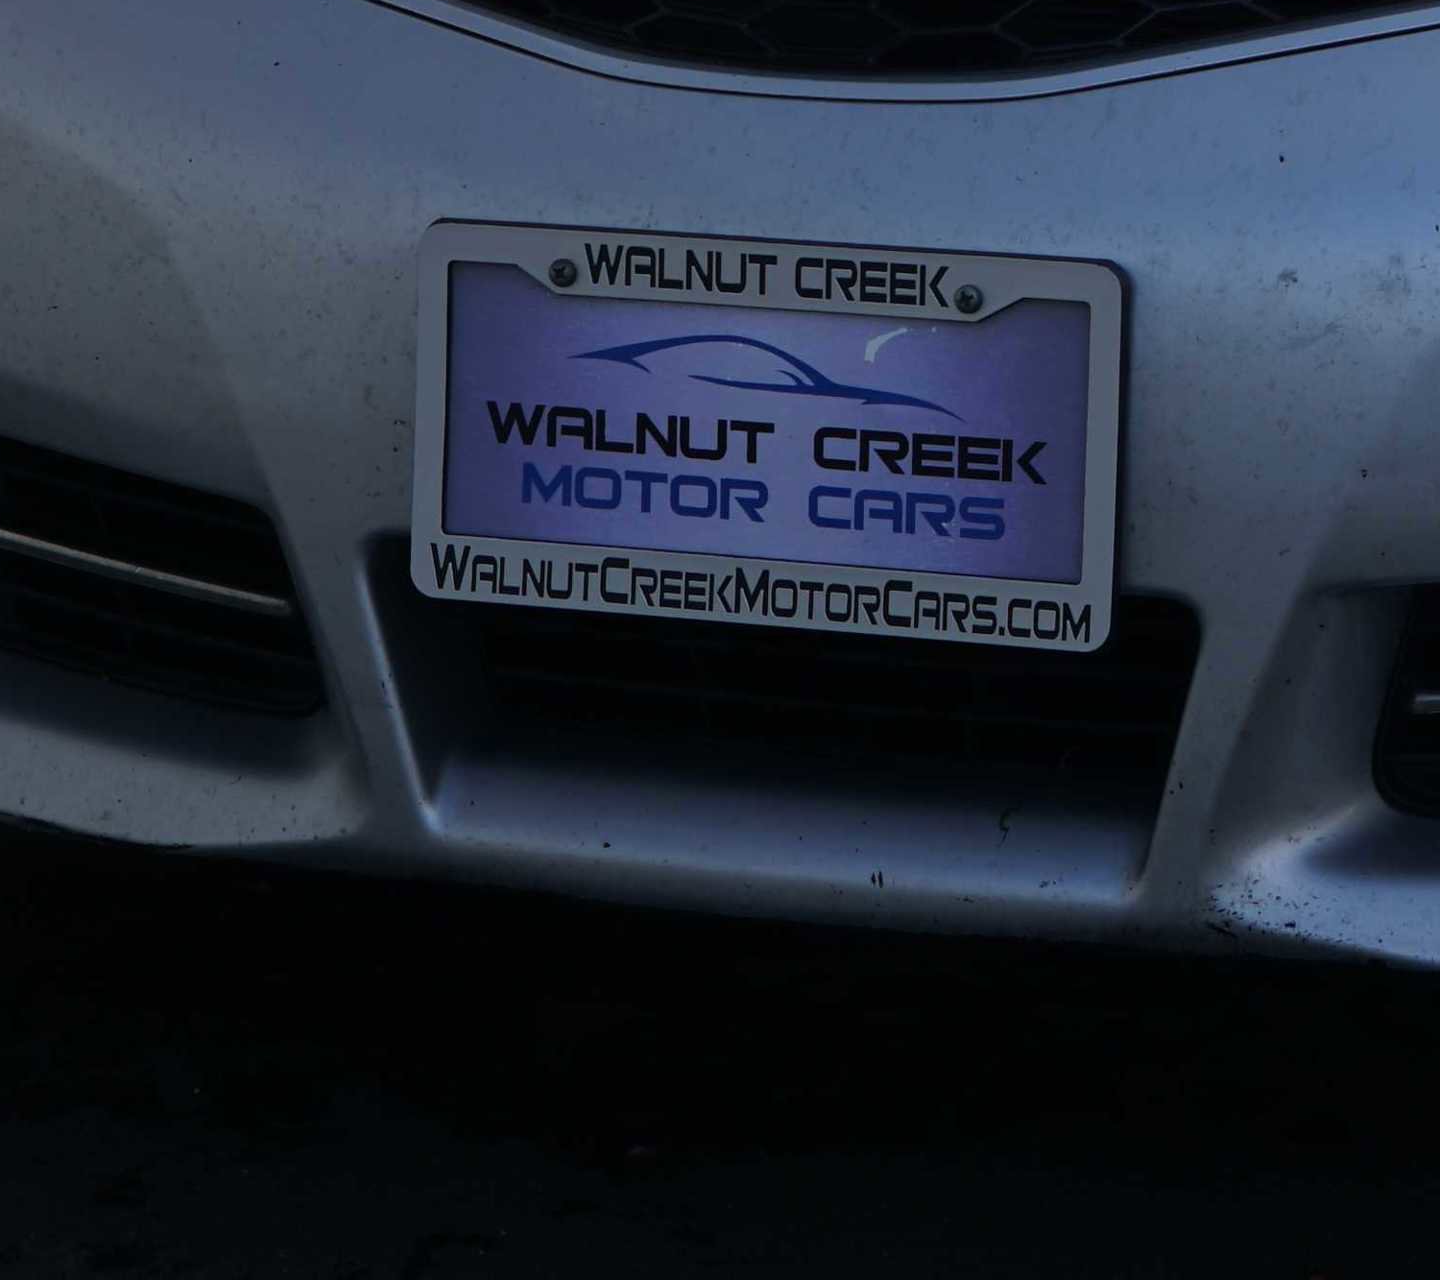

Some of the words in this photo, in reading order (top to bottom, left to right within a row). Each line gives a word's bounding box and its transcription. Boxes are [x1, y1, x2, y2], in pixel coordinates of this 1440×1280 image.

[584, 243, 778, 297] WALNUT
[795, 256, 949, 307] CREEK
[486, 400, 775, 464] WALNUT
[813, 426, 1048, 485] CREEK
[521, 461, 769, 523] MOTOR
[807, 484, 1006, 541] CARS
